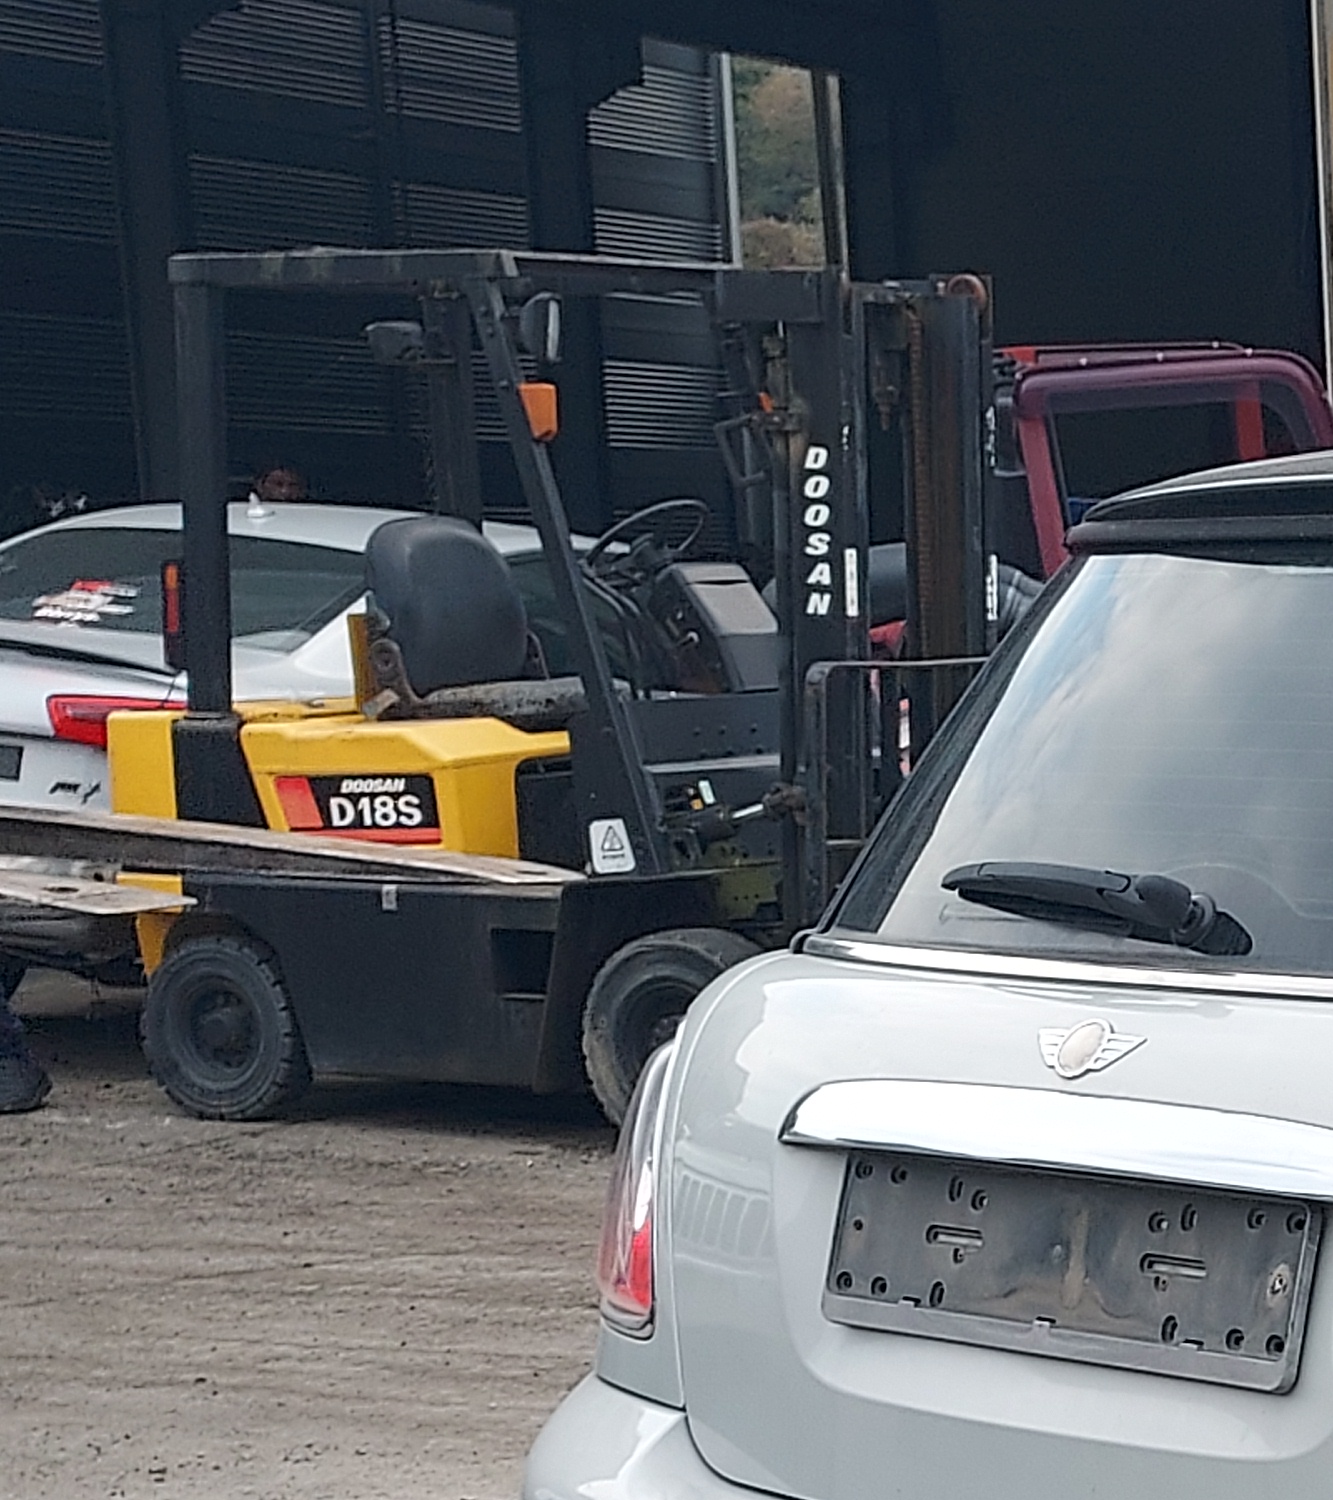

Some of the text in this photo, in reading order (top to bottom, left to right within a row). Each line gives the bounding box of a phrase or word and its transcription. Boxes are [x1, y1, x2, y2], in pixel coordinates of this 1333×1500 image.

[803, 445, 832, 616] DOOSAN
[340, 778, 406, 794] DOOSAN
[329, 794, 423, 827] D18S
